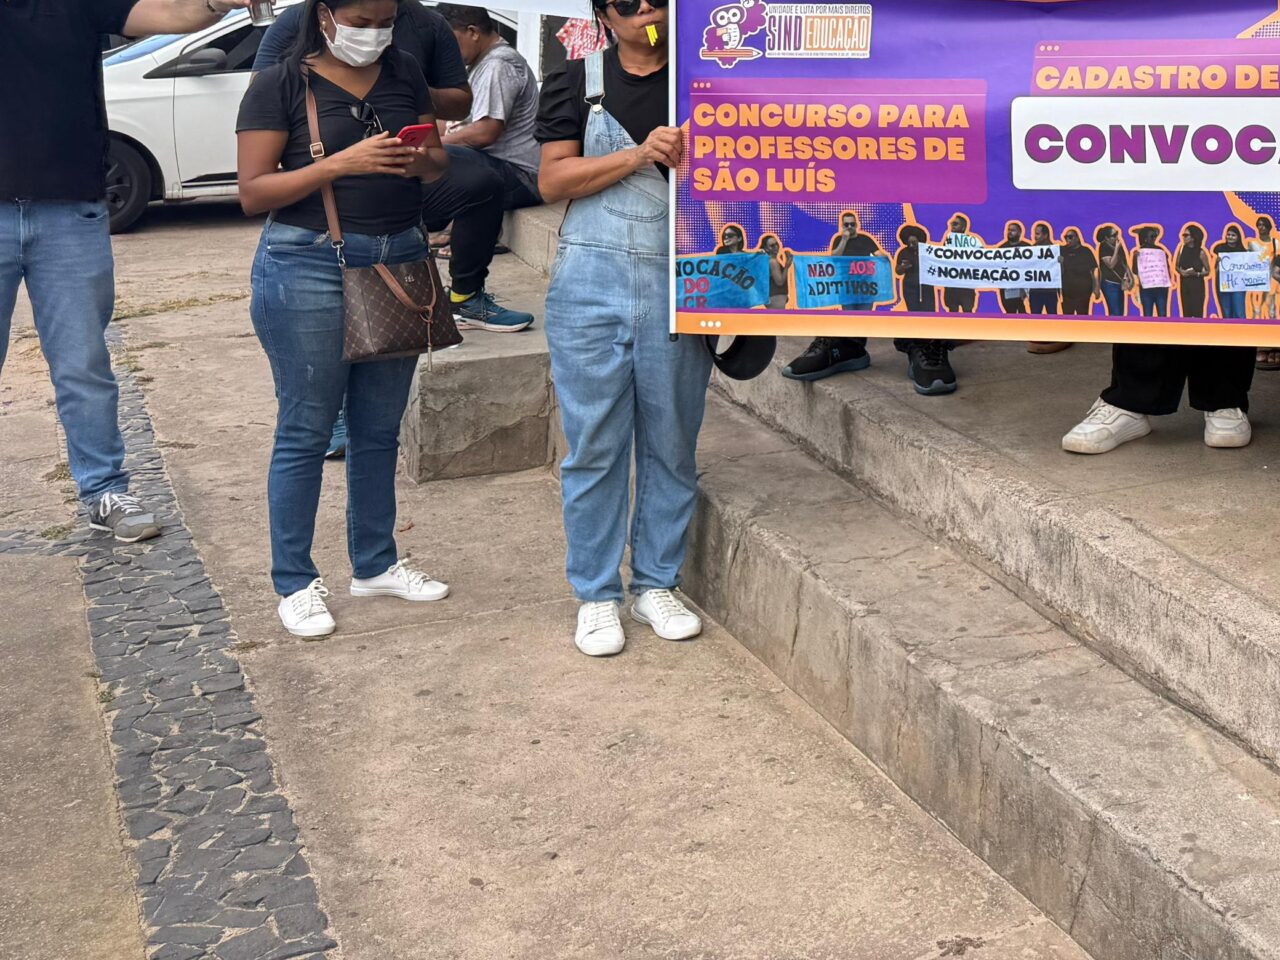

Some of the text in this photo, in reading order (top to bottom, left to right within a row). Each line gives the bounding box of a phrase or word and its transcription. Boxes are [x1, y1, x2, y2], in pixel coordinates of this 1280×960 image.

[768, 5, 794, 14] UNIDADE
[800, 5, 814, 14] LUTA
[816, 5, 827, 14] POR
[829, 5, 844, 14] MAIS
[845, 5, 870, 14] DIREITOS
[1035, 64, 1227, 90] CADASTRO
[1235, 64, 1279, 90] DE
[693, 102, 970, 128] CONCURSO PARA
[694, 135, 965, 161] PROFESSORES DE
[693, 161, 836, 193] SÃO LUÍS
[848, 260, 876, 276] AOS
[927, 265, 1052, 284] #NOMEAÇÃO SIM
[683, 276, 710, 295] DO
